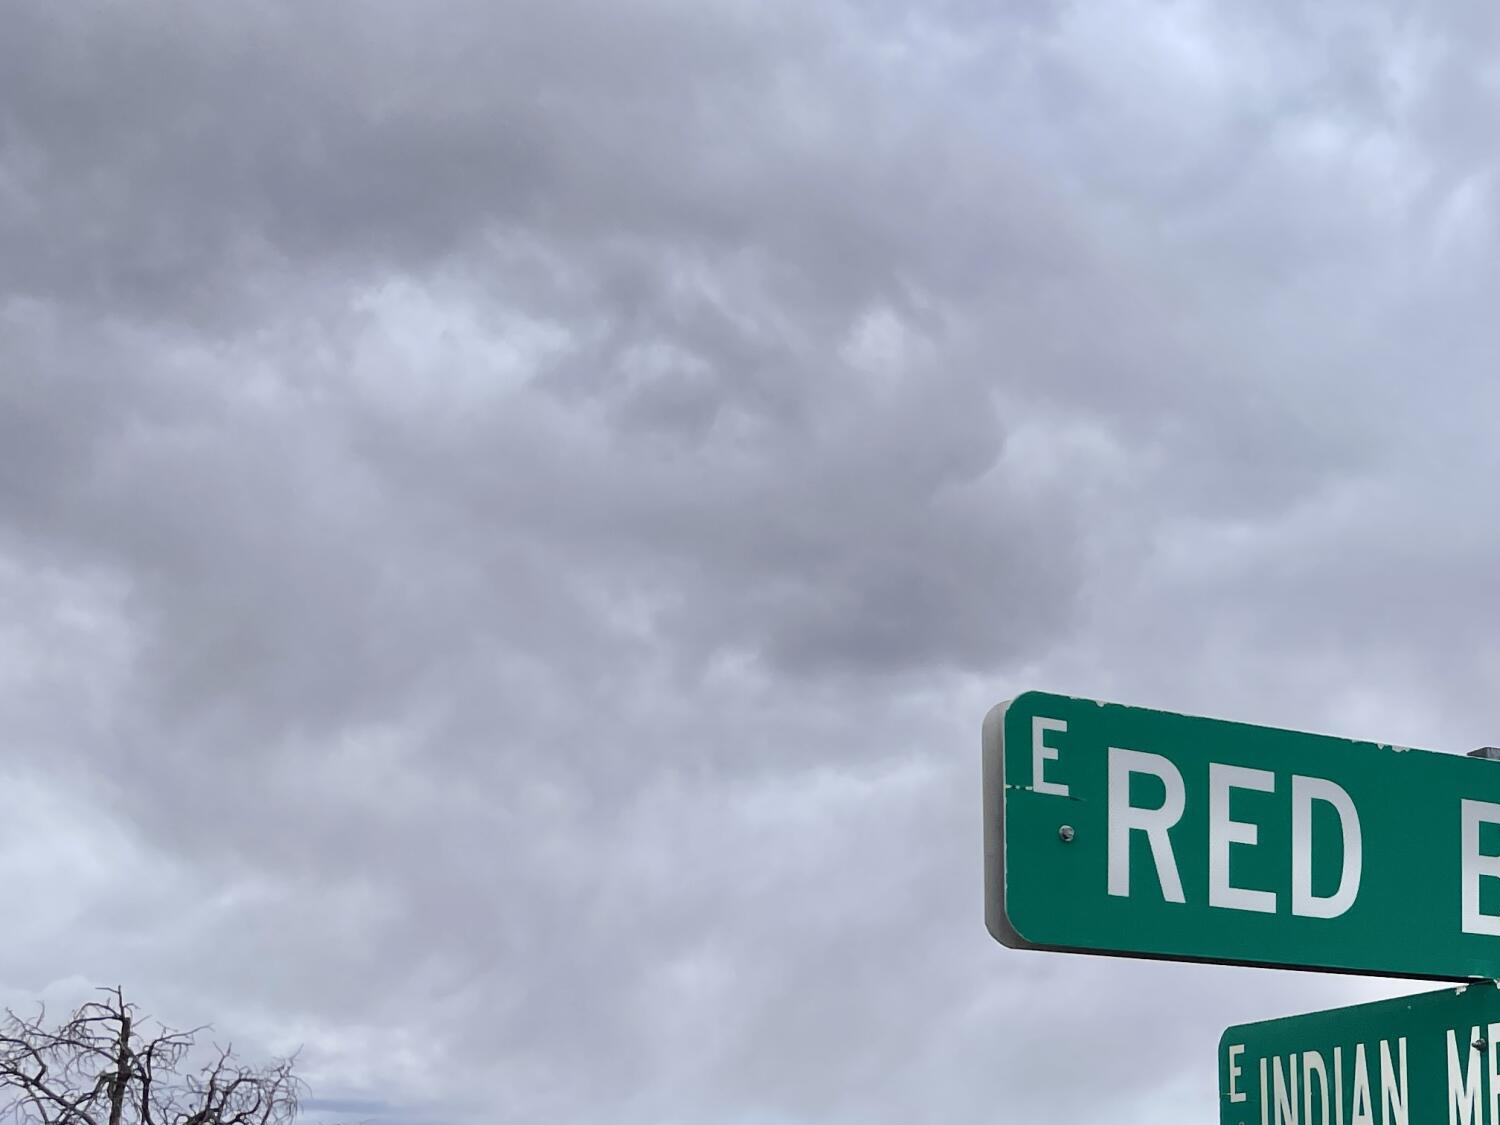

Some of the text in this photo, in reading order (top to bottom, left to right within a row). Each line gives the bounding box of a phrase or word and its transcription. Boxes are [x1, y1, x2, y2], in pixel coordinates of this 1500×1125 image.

[1032, 716, 1069, 796] E
[1107, 746, 1362, 919] RED
[1229, 1044, 1246, 1104] E
